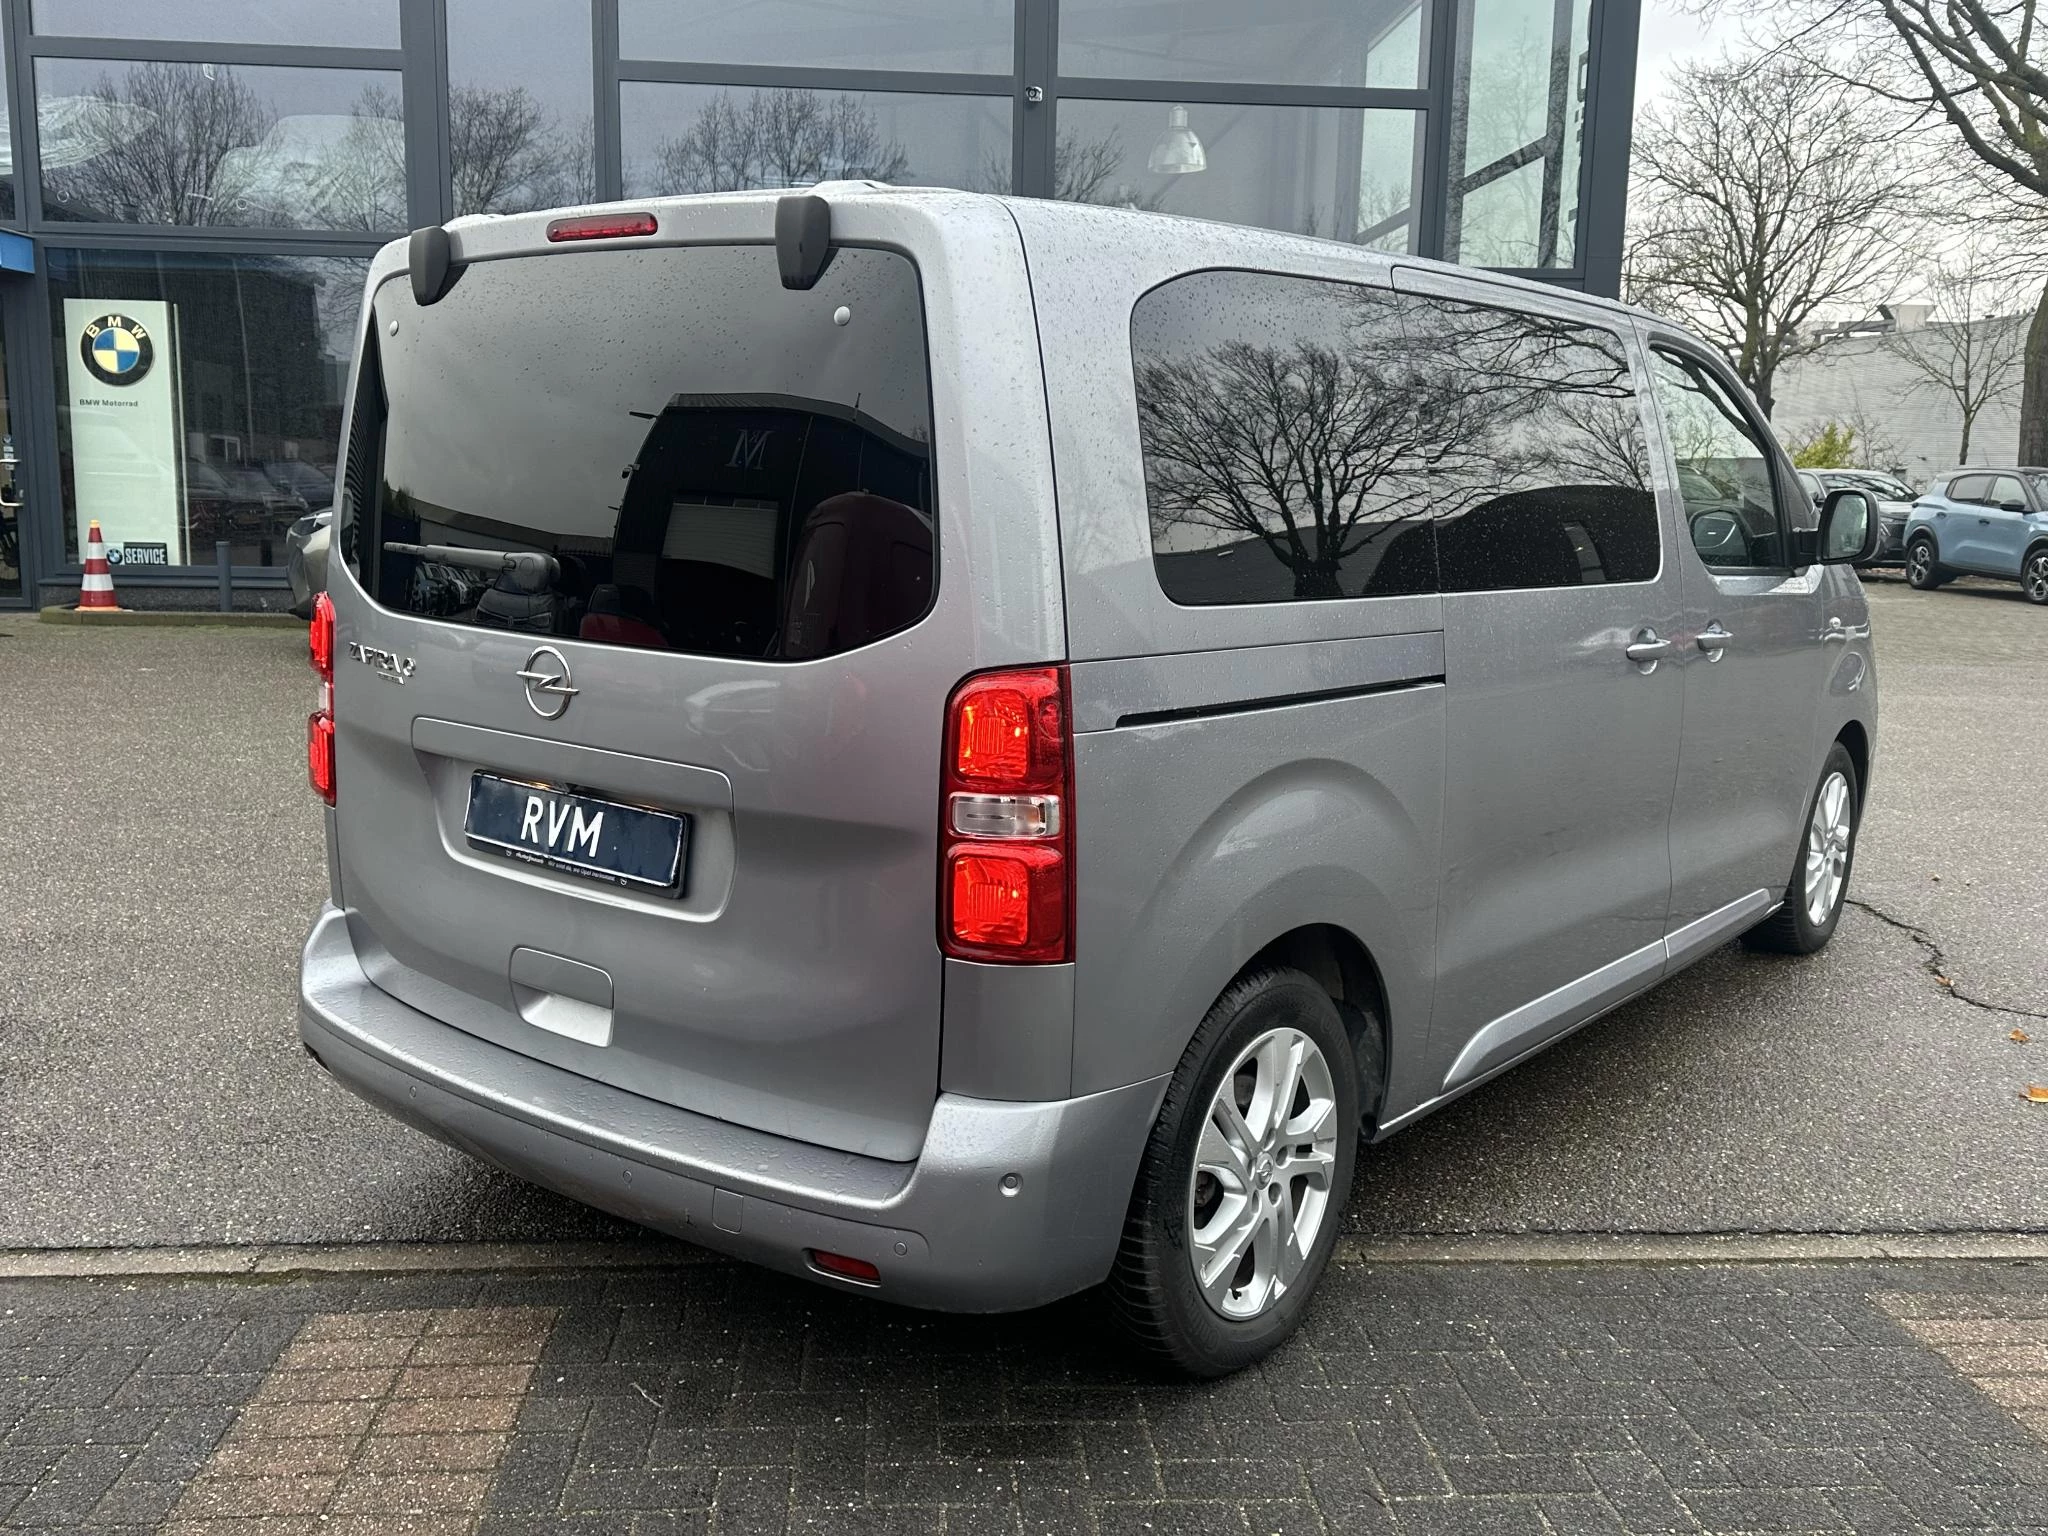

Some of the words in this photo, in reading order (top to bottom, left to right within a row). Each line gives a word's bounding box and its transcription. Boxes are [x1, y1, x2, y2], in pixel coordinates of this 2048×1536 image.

[85, 315, 147, 340] BMW
[79, 398, 100, 406] BMW
[101, 399, 139, 407] Motorrad
[125, 548, 166, 564] SERVICE
[520, 796, 604, 858] RVM
